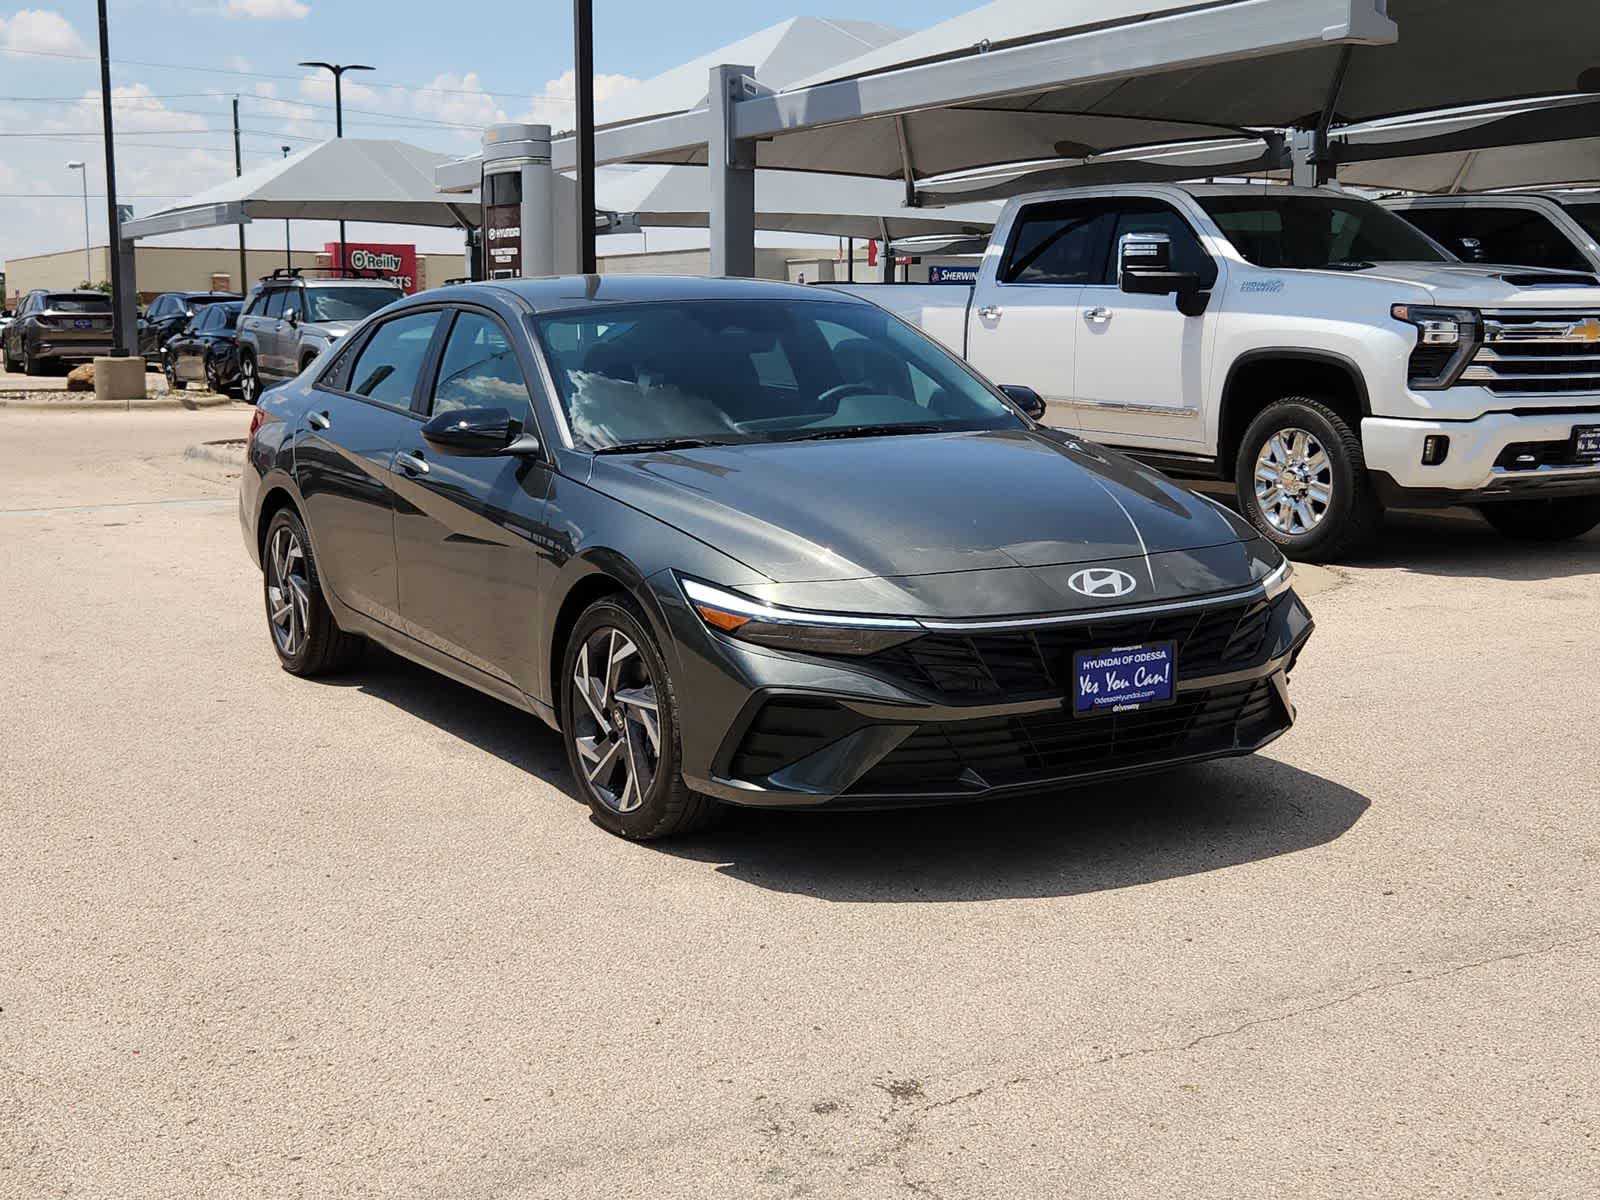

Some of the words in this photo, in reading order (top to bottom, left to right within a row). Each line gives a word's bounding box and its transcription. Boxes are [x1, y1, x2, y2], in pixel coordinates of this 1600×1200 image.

[352, 251, 401, 272] O'Reilly
[941, 270, 978, 280] SHERWIN
[1083, 657, 1121, 670] HYUNDAI
[1122, 655, 1134, 665] OF
[1134, 650, 1167, 662] ODESSA
[1080, 674, 1099, 696] Yes
[1106, 671, 1130, 692] You
[1134, 662, 1170, 688] Can!
